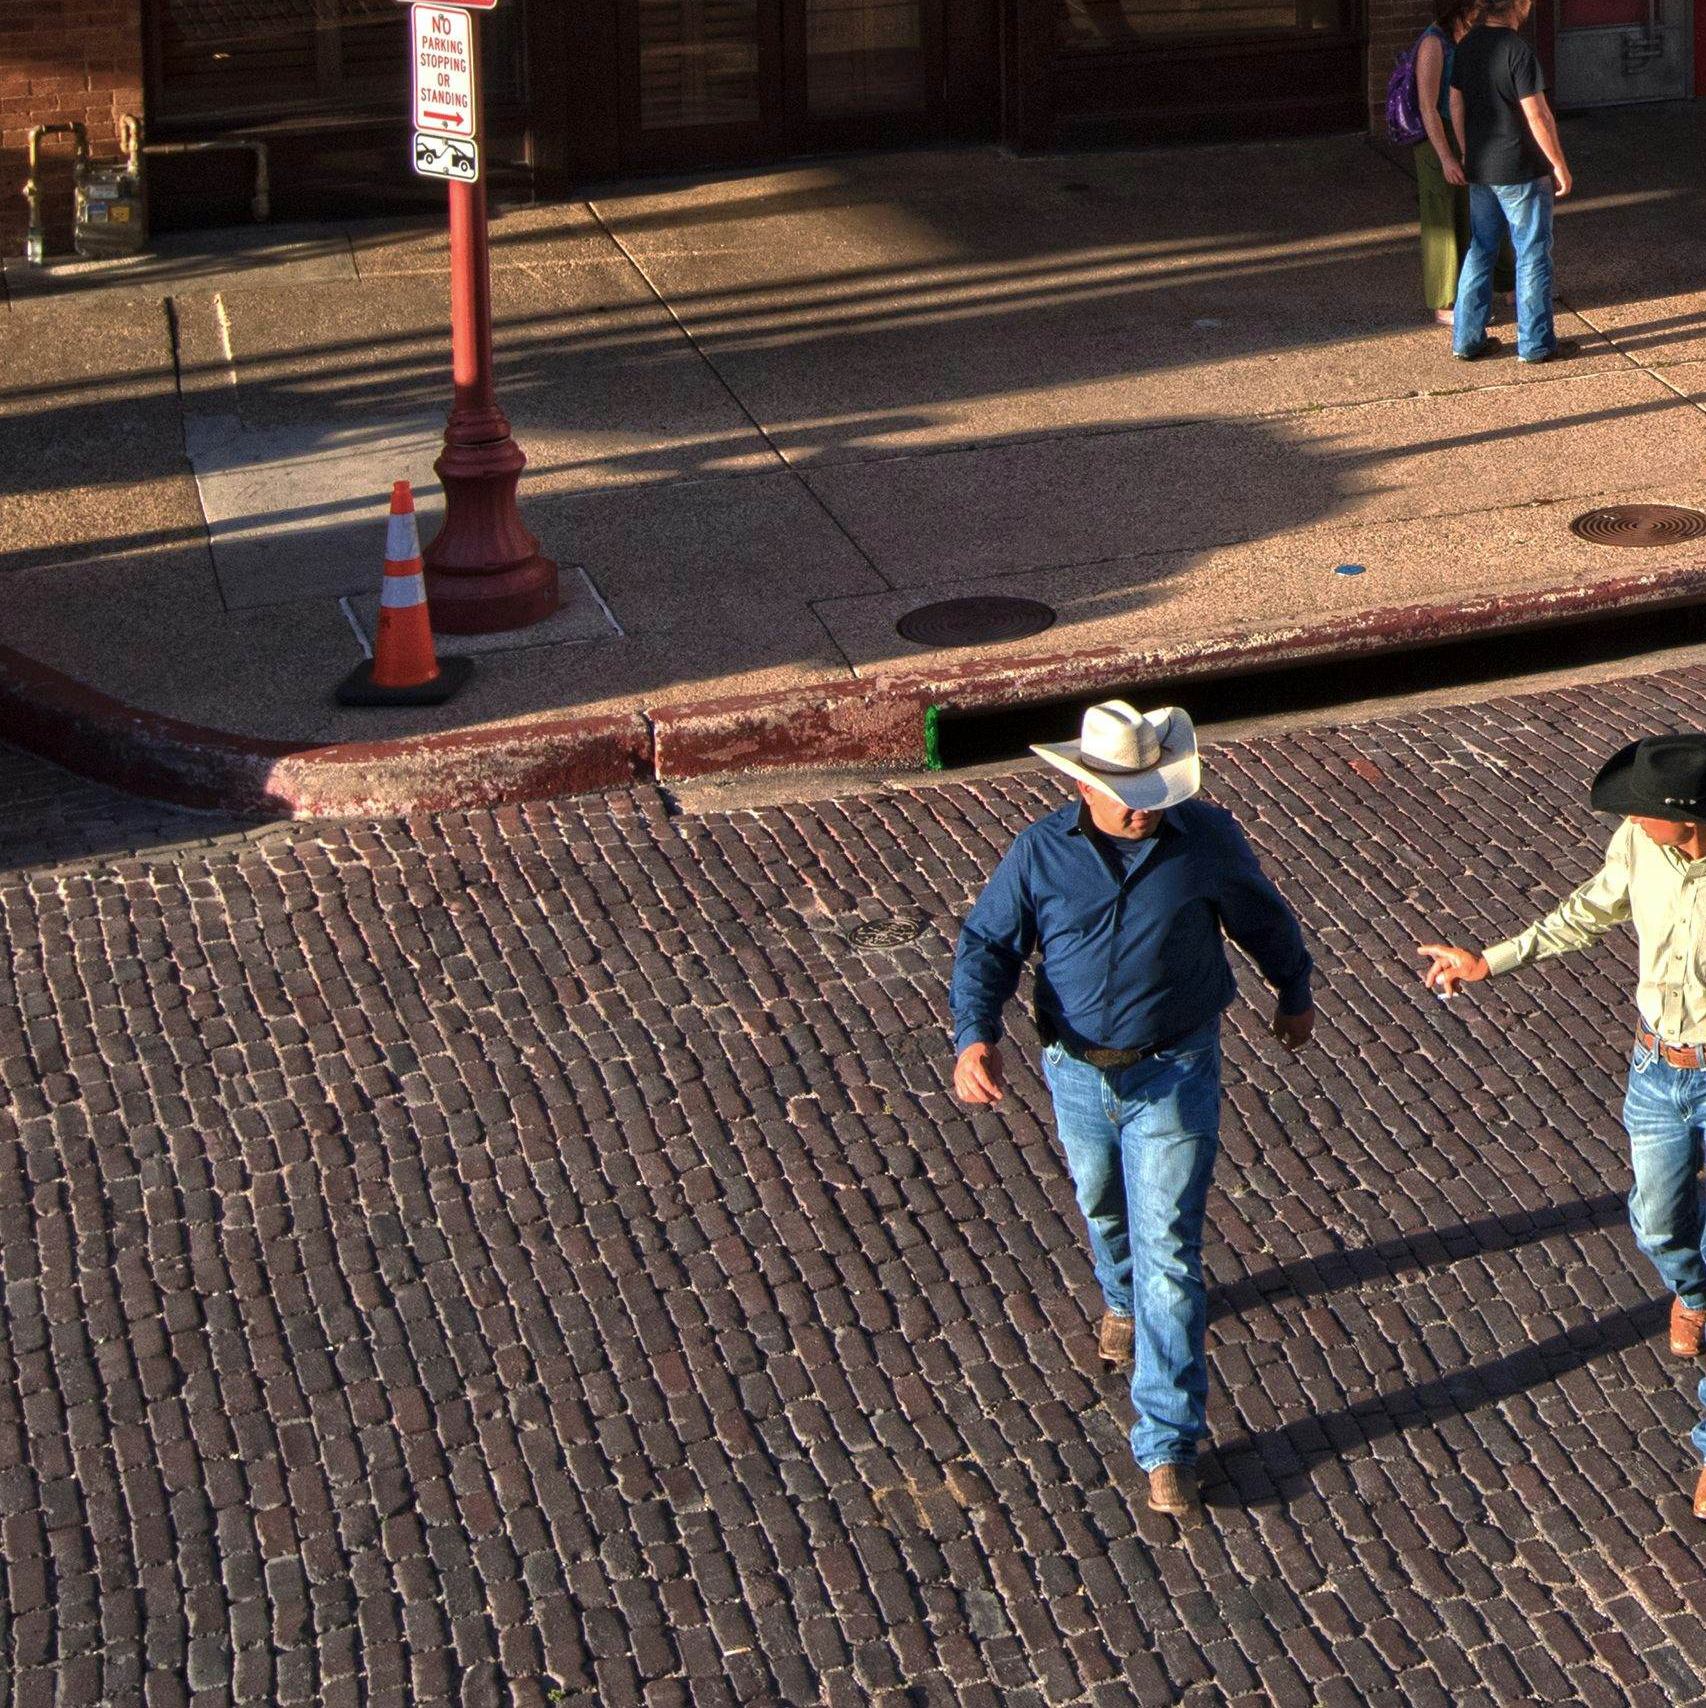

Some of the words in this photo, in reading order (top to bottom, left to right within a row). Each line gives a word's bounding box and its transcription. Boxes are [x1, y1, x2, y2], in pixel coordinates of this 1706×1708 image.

[432, 16, 452, 35] NO
[422, 35, 463, 55] PARKING
[420, 53, 467, 73] STOPPING
[437, 72, 450, 88] OR
[420, 87, 468, 108] STANDING
